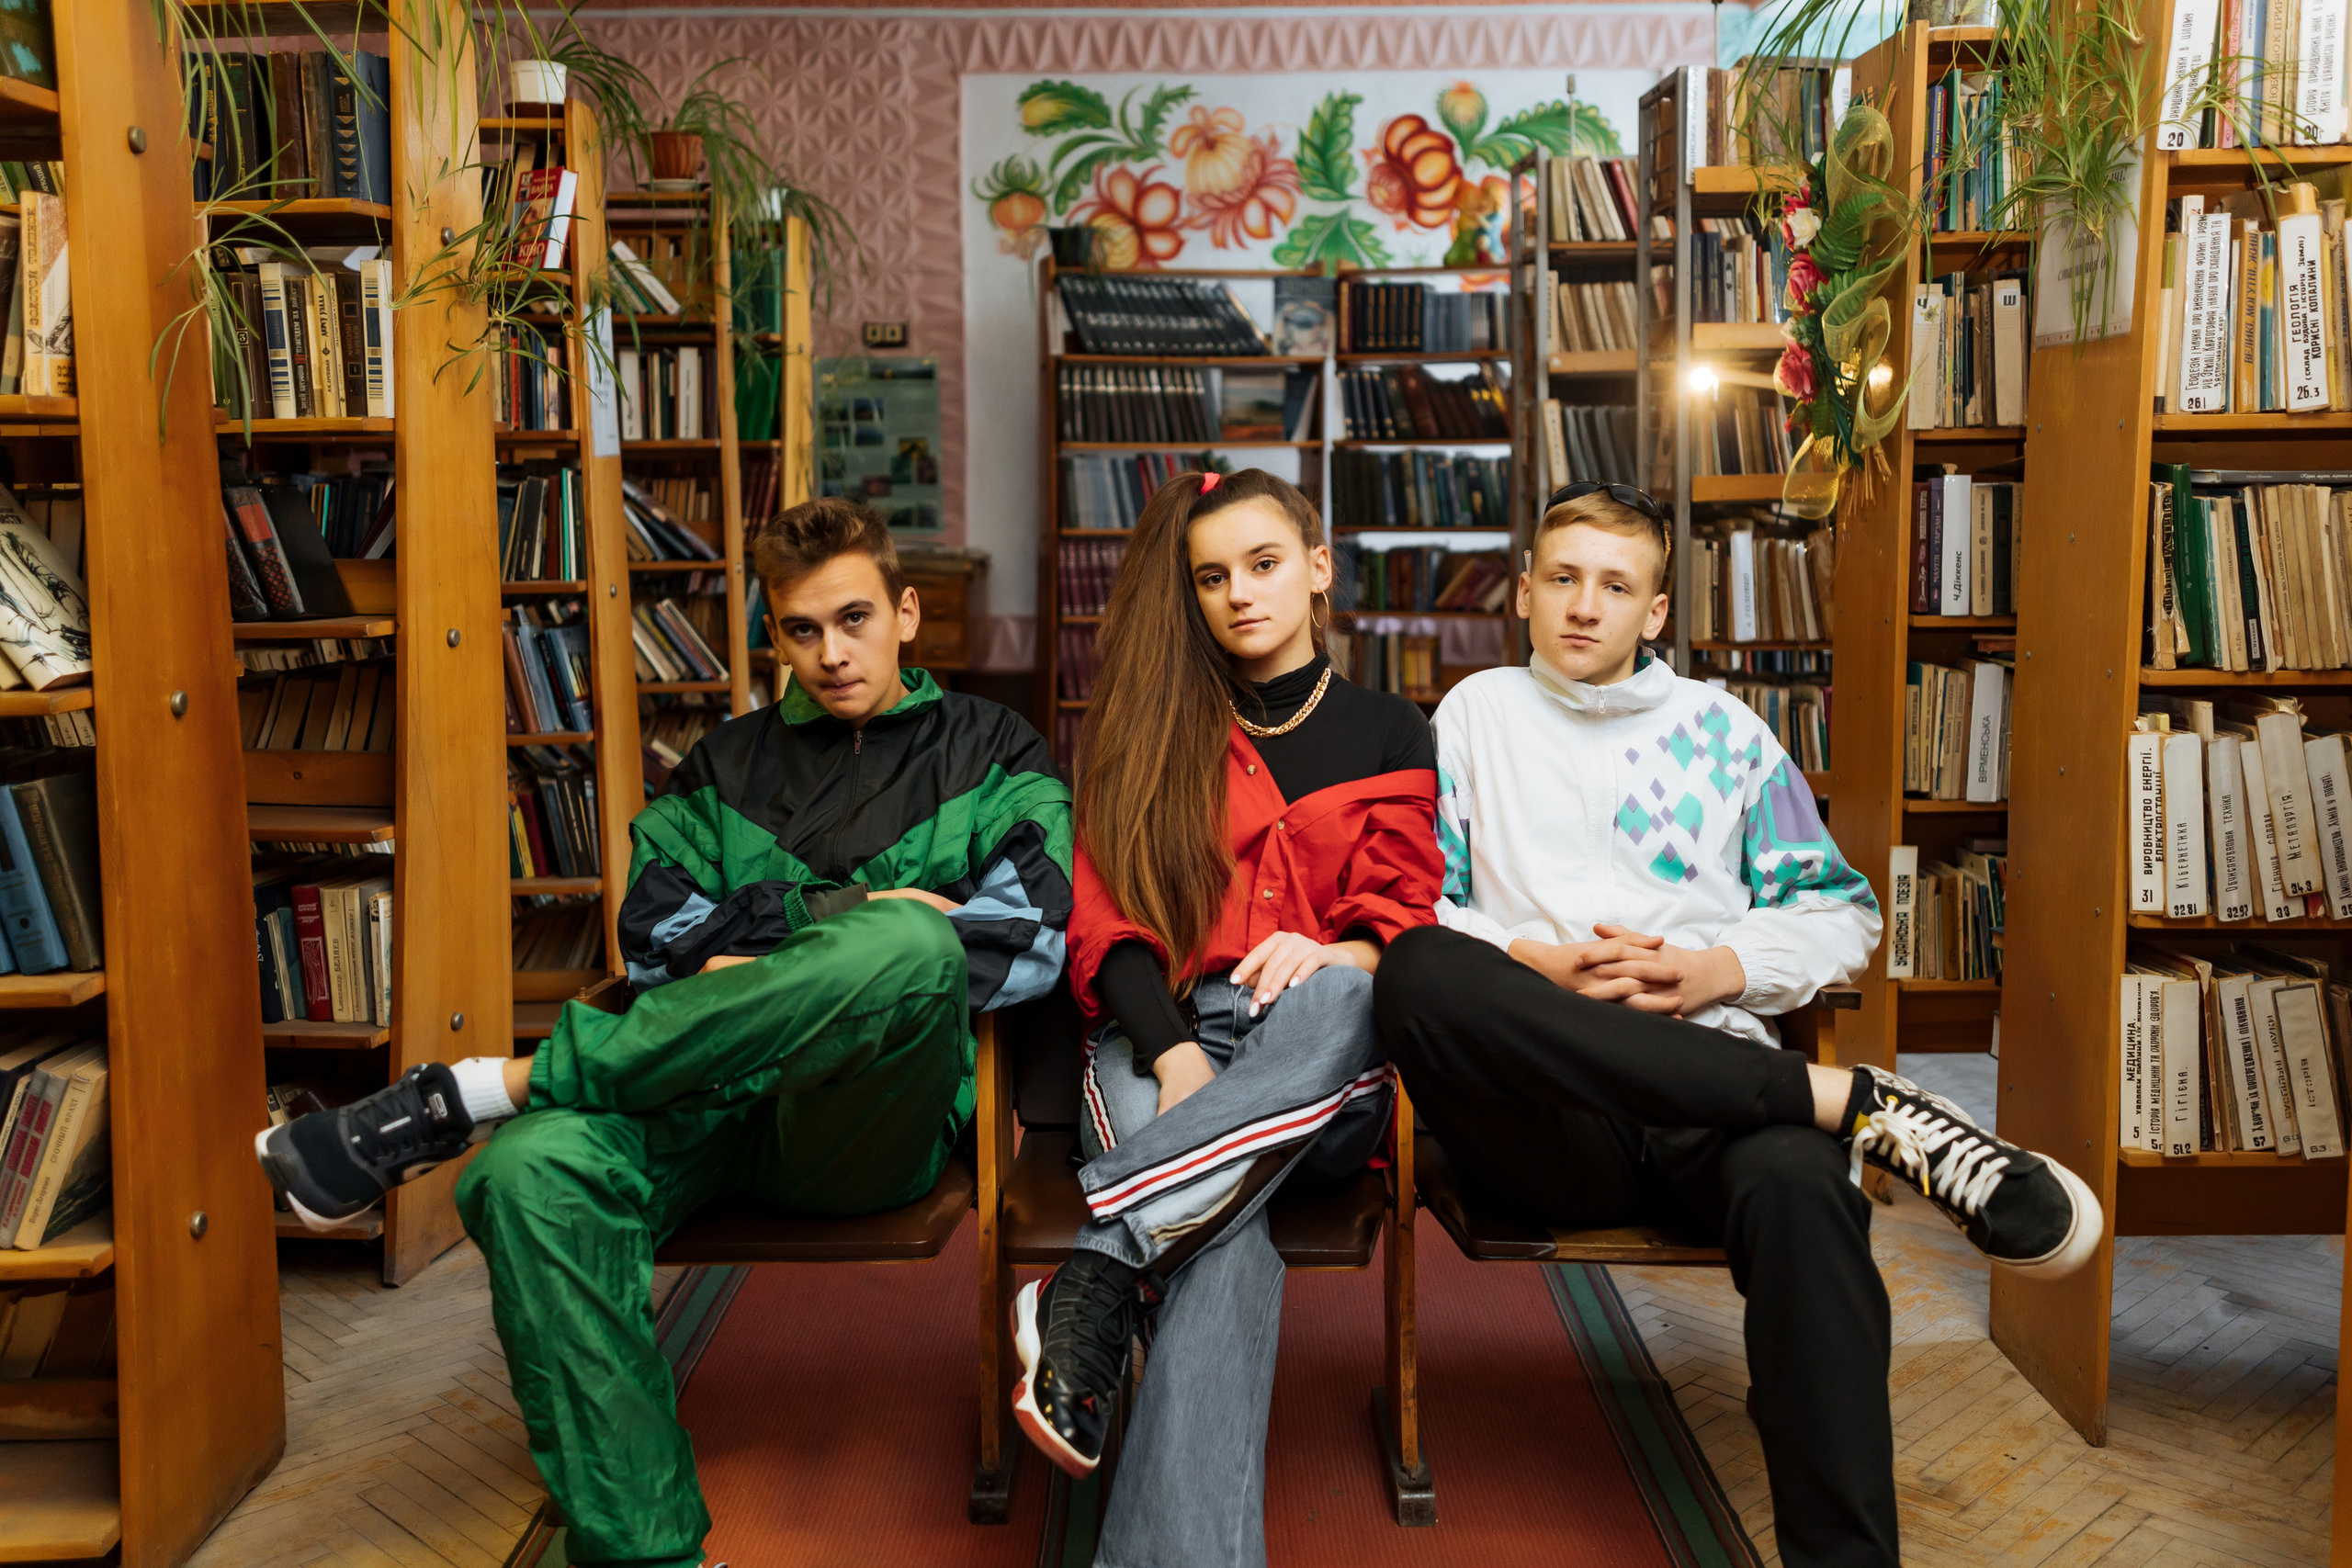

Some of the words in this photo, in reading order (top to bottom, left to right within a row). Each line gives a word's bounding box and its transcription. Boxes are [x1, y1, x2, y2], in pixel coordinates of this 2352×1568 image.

[2167, 131, 2184, 147] 20
[2247, 231, 2259, 263] ЖИВІ
[2003, 295, 2016, 306] Ш
[2245, 267, 2257, 318] МОГУТНІ,
[2299, 273, 2307, 304] ІСТОРІЯ
[2307, 259, 2319, 312] КОПАЛИНИ
[2289, 283, 2302, 343] ГЕОЛОГІЯ
[2301, 312, 2310, 344] БУДОВА
[2244, 321, 2256, 365] ВЕЛИКІ,
[2310, 319, 2322, 360] КОРИСНІ
[2302, 348, 2312, 381] (СКЛАД
[2188, 397, 2207, 411] 26.1
[2297, 385, 2321, 401] 26.3
[2162, 496, 2173, 558] РАСТЕНИЯ
[1952, 550, 1962, 602] Ч.Діккенс
[1978, 715, 1992, 784] ВІРМЕНСЬКА
[2140, 747, 2154, 791] ЕНЕРГІЇ.
[2143, 797, 2154, 875] ВИРОБНИЦТВО
[1895, 874, 1911, 905] ПОЕЗІЯ
[2142, 889, 2154, 903] 31
[2276, 905, 2290, 918] 33
[333, 938, 341, 972] БЕЛЯЕВ
[1893, 912, 1911, 967] УКРАЇНСЬКА
[2126, 1017, 2137, 1082] МЕДИЦИНА.
[2267, 1015, 2279, 1054] НАУКИ
[51, 1126, 69, 1164] СРОЧНЫЙ
[64, 1097, 78, 1123] ФРАХТ
[2132, 1126, 2140, 1139] 5
[2253, 1136, 2266, 1147] 57
